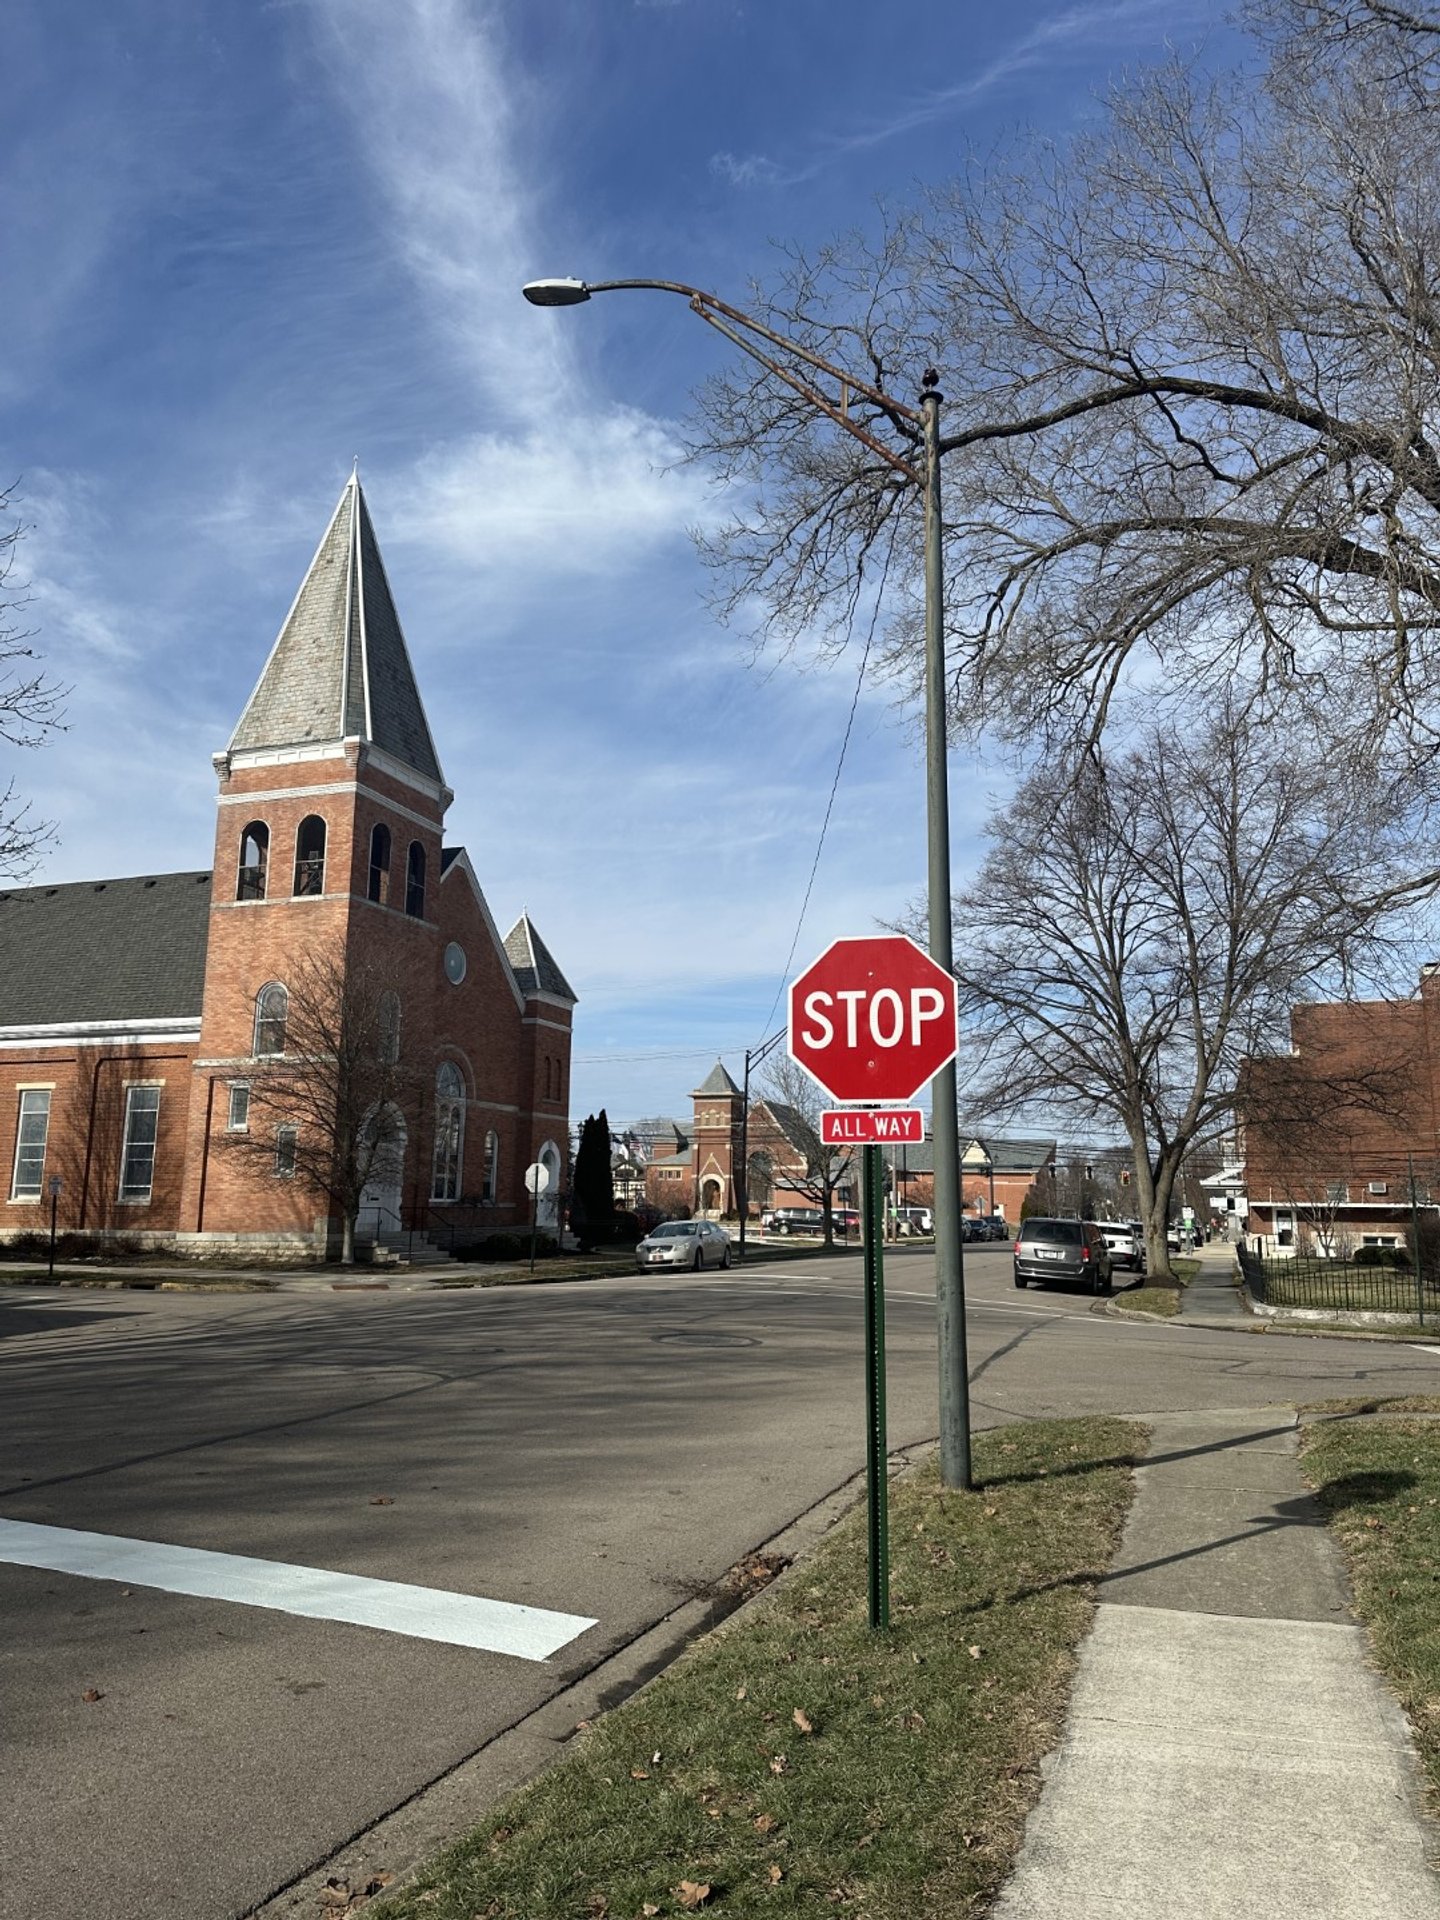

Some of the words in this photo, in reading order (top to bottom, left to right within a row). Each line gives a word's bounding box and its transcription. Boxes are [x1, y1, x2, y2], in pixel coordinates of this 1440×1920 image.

[802, 988, 945, 1049] STOP
[831, 1118, 866, 1137] ALL
[875, 1116, 913, 1136] WAY
